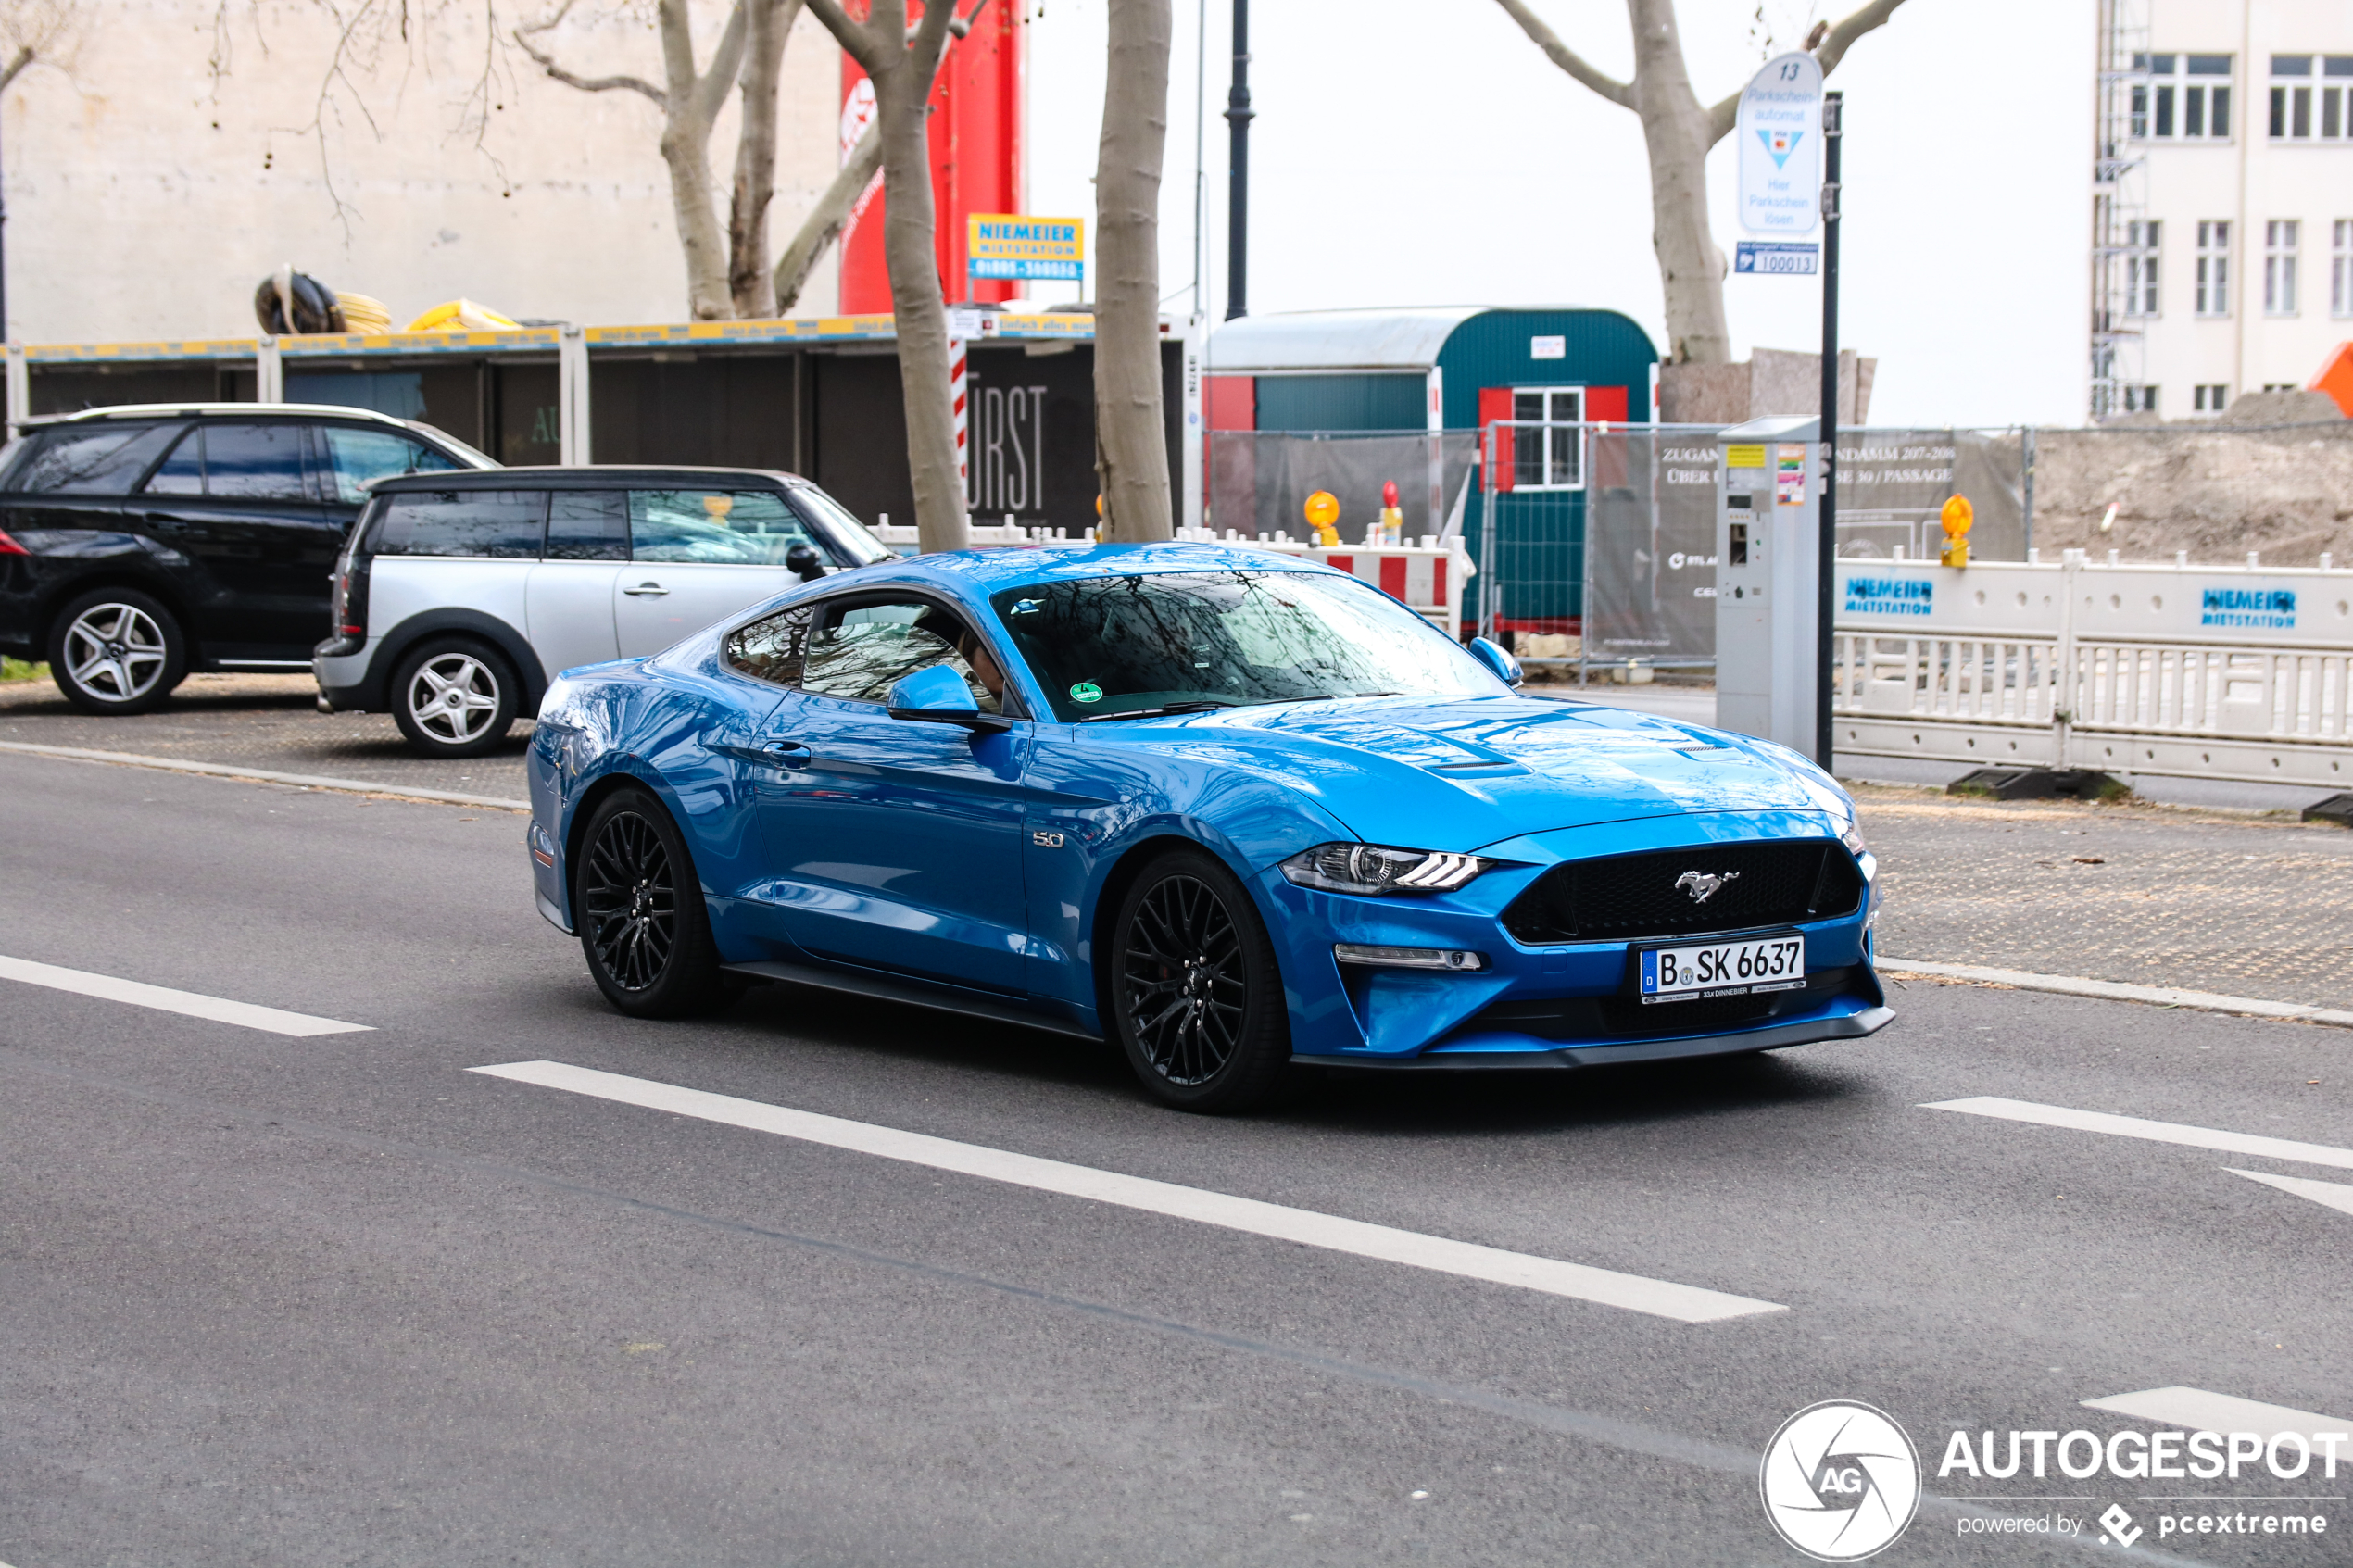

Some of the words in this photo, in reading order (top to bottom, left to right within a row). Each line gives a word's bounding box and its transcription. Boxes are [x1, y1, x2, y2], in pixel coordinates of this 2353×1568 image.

[1780, 62, 1800, 81] 13
[1747, 87, 1816, 103] Parkschein-
[1755, 107, 1805, 121] automat
[1768, 179, 1790, 191] Hier
[1749, 194, 1808, 208] Parkschein
[1764, 210, 1793, 224] lösen
[979, 223, 1075, 241] NIEMEIER
[1763, 256, 1811, 271] 100013
[1667, 467, 1710, 483] ÜBER
[1883, 468, 1953, 483] PASSAGE
[1847, 579, 1932, 599] NIEMEIER
[1845, 600, 1931, 615] MIETSTATION
[2203, 589, 2296, 611] NIEMEIER
[2200, 613, 2295, 629] MIETSTATION
[1080, 684, 1090, 693] 4
[1033, 831, 1064, 848] 5.0
[1646, 976, 1653, 986] D
[1661, 953, 1678, 986] B
[1697, 947, 1730, 983] SK
[1737, 941, 1800, 979] 6637
[1715, 986, 1748, 997] DINNEBIER
